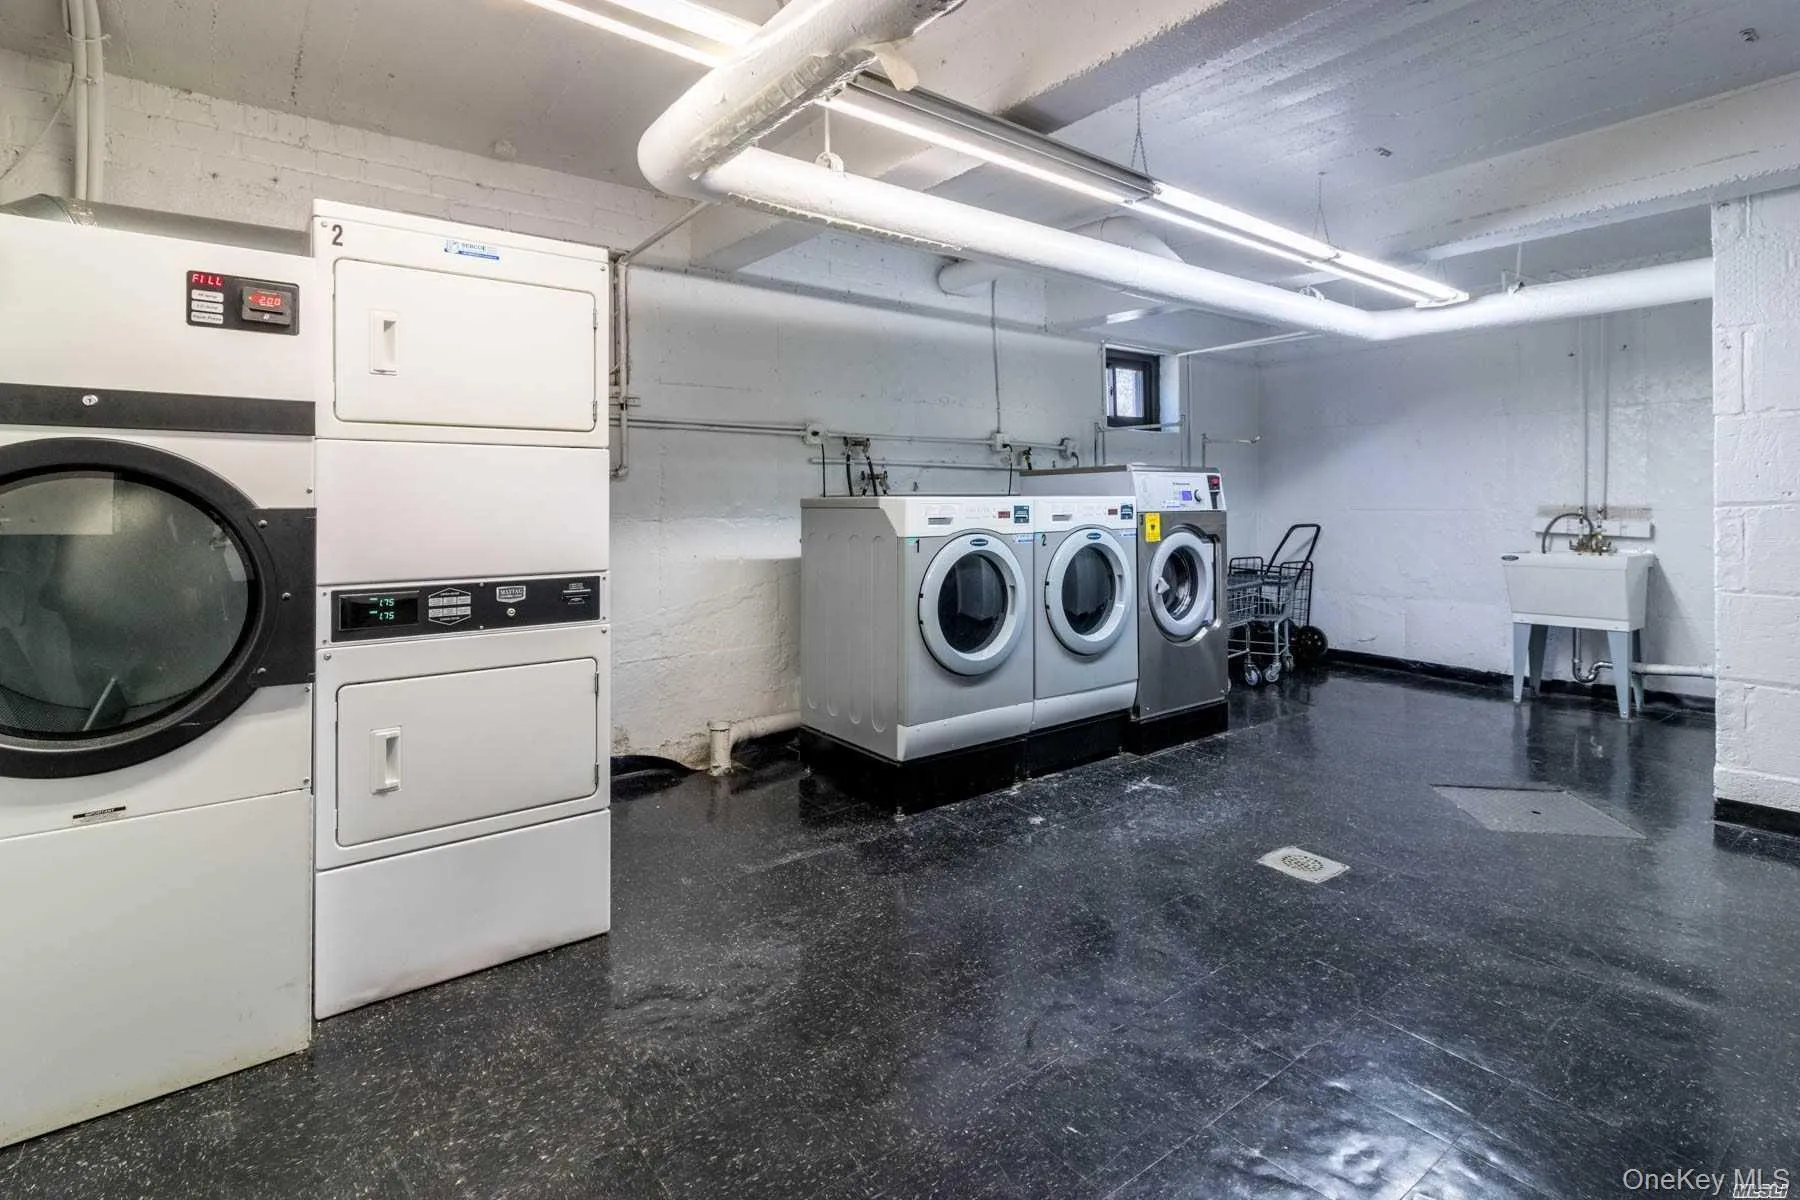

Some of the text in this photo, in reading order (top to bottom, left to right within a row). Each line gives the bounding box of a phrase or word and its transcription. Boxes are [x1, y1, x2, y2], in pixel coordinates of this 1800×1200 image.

[332, 224, 343, 246] 2
[192, 273, 222, 286] FILL
[1041, 534, 1047, 547] 2
